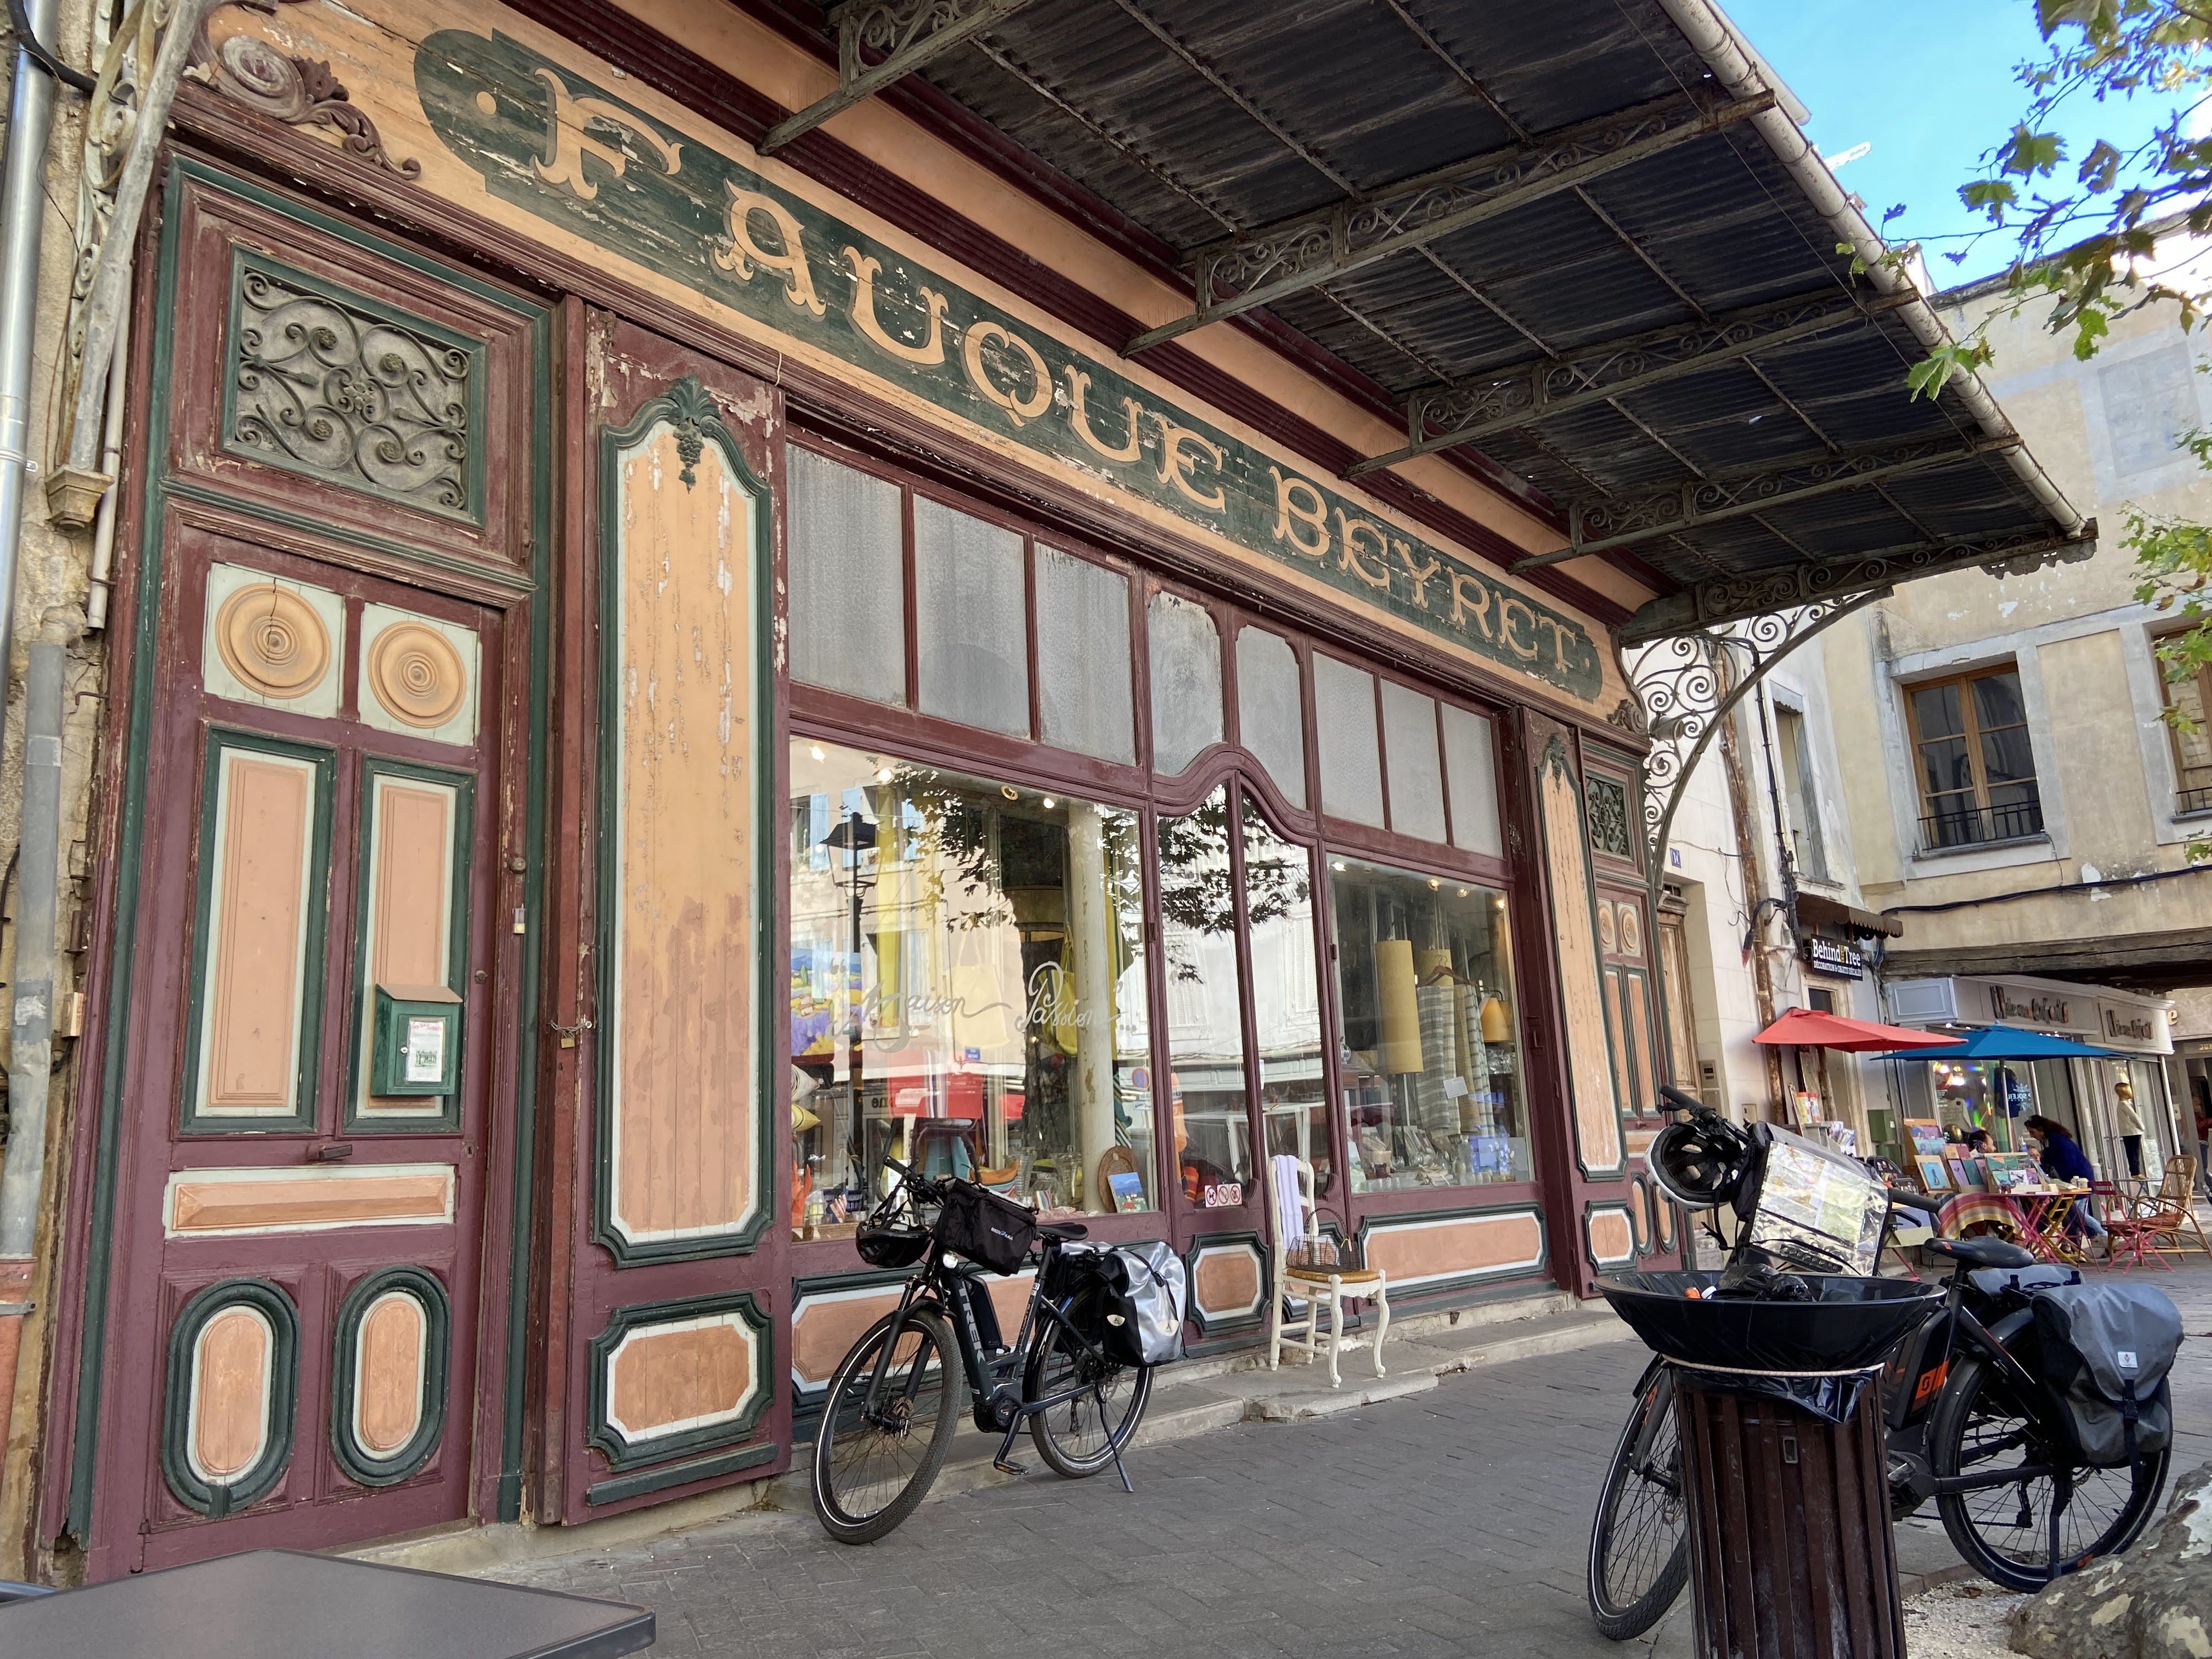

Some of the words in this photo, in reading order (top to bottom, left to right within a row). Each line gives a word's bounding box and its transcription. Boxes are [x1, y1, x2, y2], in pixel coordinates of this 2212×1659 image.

[531, 67, 1226, 516] FAUQUE
[1269, 466, 1576, 672] BEYRET
[1812, 938, 1841, 962] Behind
[1844, 946, 1861, 967] Tree
[958, 1280, 986, 1364] TREK
